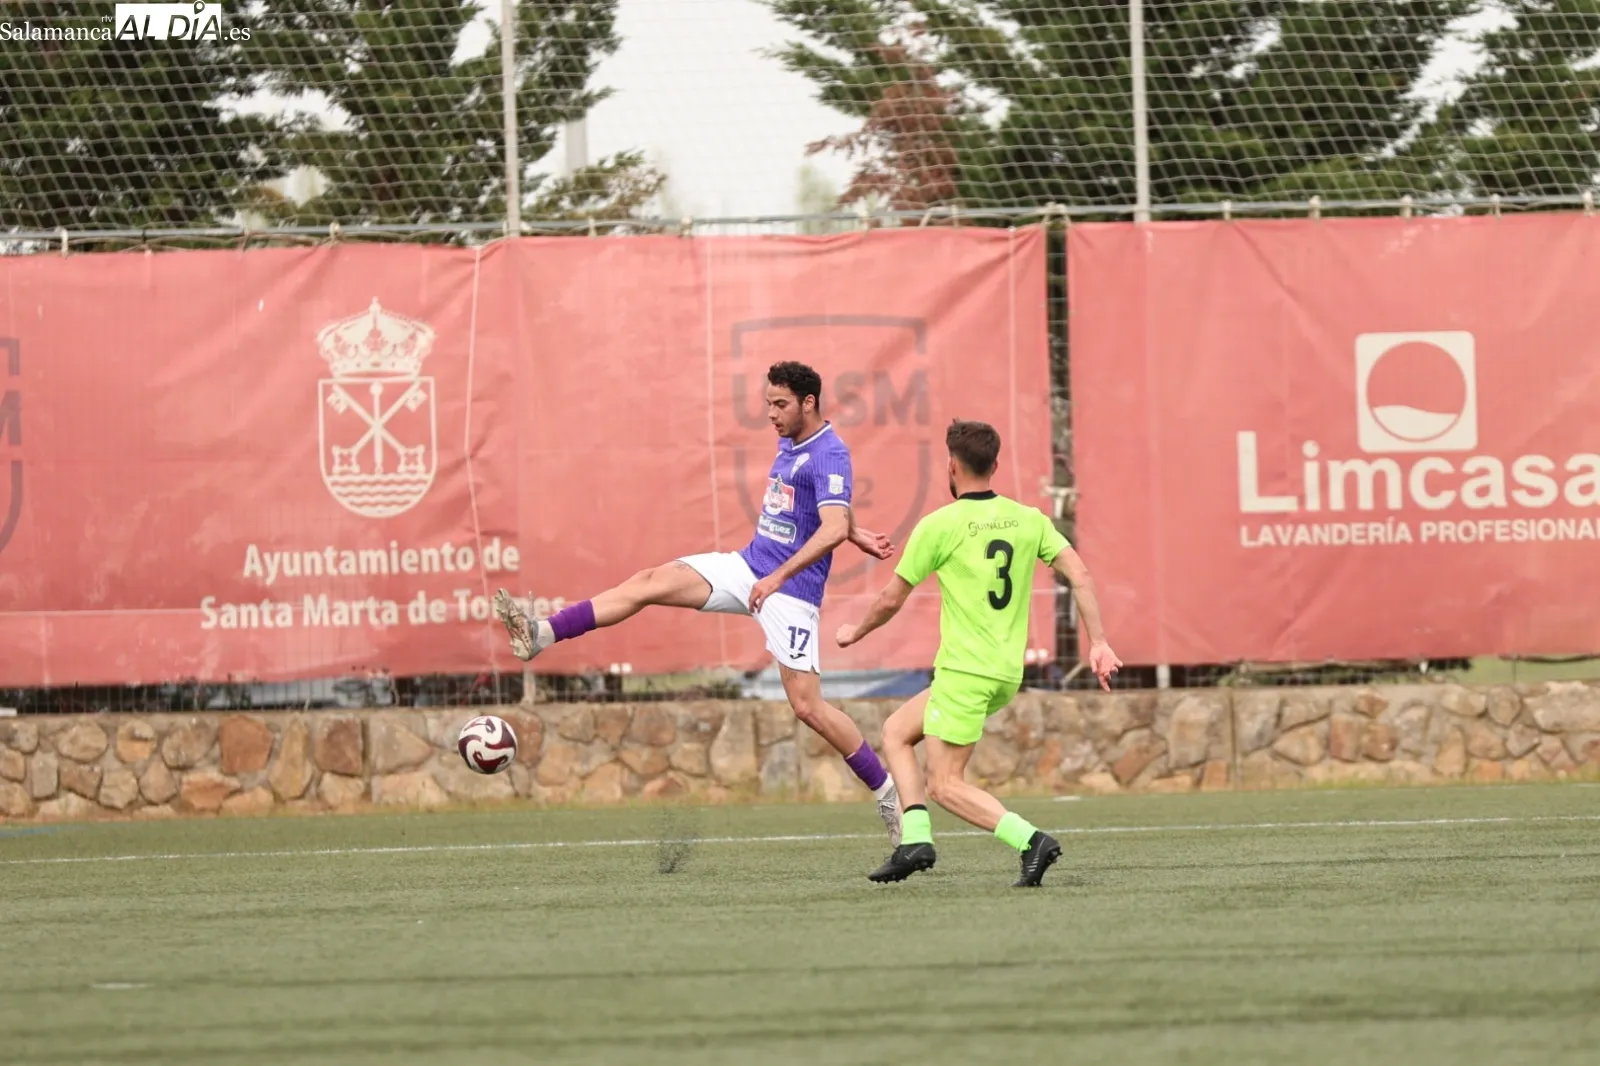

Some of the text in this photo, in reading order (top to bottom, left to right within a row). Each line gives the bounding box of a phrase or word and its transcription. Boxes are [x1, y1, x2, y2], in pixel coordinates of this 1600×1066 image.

[732, 370, 930, 430] USM
[1237, 430, 1600, 513] Limcasa
[1240, 516, 1413, 548] LAVANDERÍA
[243, 538, 520, 584] Ayuntamiento de
[984, 539, 1014, 610] 3
[201, 596, 293, 629] Santa
[303, 593, 399, 627] Marta
[408, 591, 446, 625] de
[788, 626, 810, 651] 17
